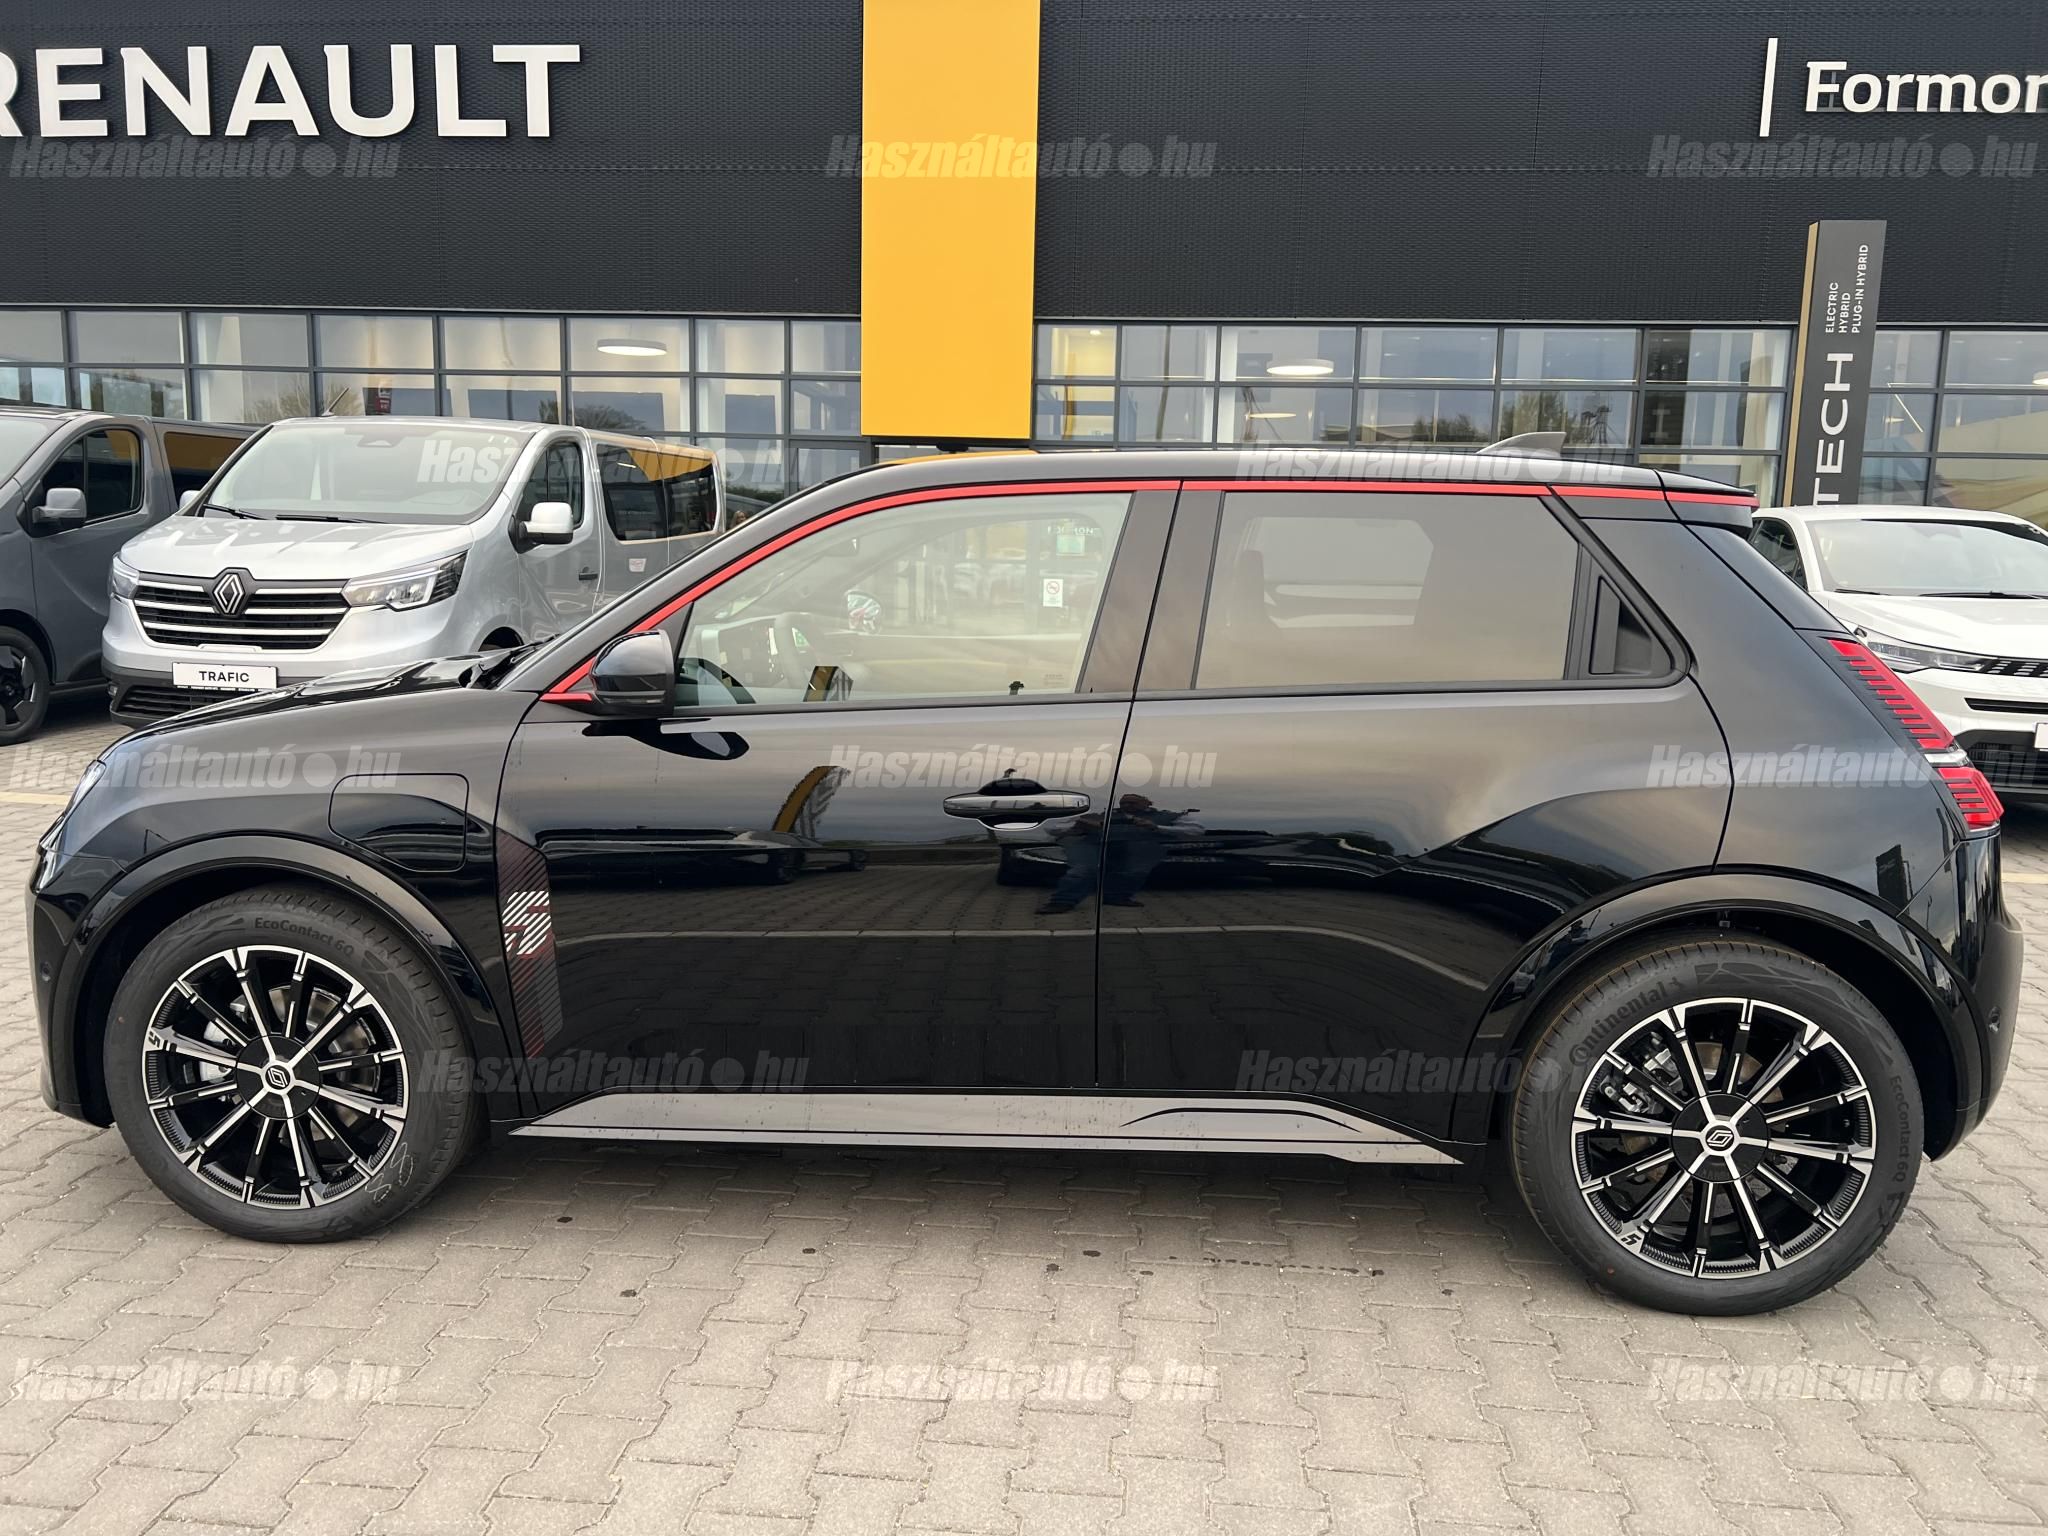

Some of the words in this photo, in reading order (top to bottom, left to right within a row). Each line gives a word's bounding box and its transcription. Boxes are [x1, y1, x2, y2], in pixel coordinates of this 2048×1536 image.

[1855, 244, 1869, 286] HYBRID
[1825, 282, 1839, 333] ELECTRIC
[1838, 292, 1851, 333] HYBRID
[1851, 288, 1865, 333] PLUG-IN
[198, 670, 250, 683] TRAFIC
[254, 917, 334, 946] EcoContact
[1889, 1075, 1912, 1161] EcoContact
